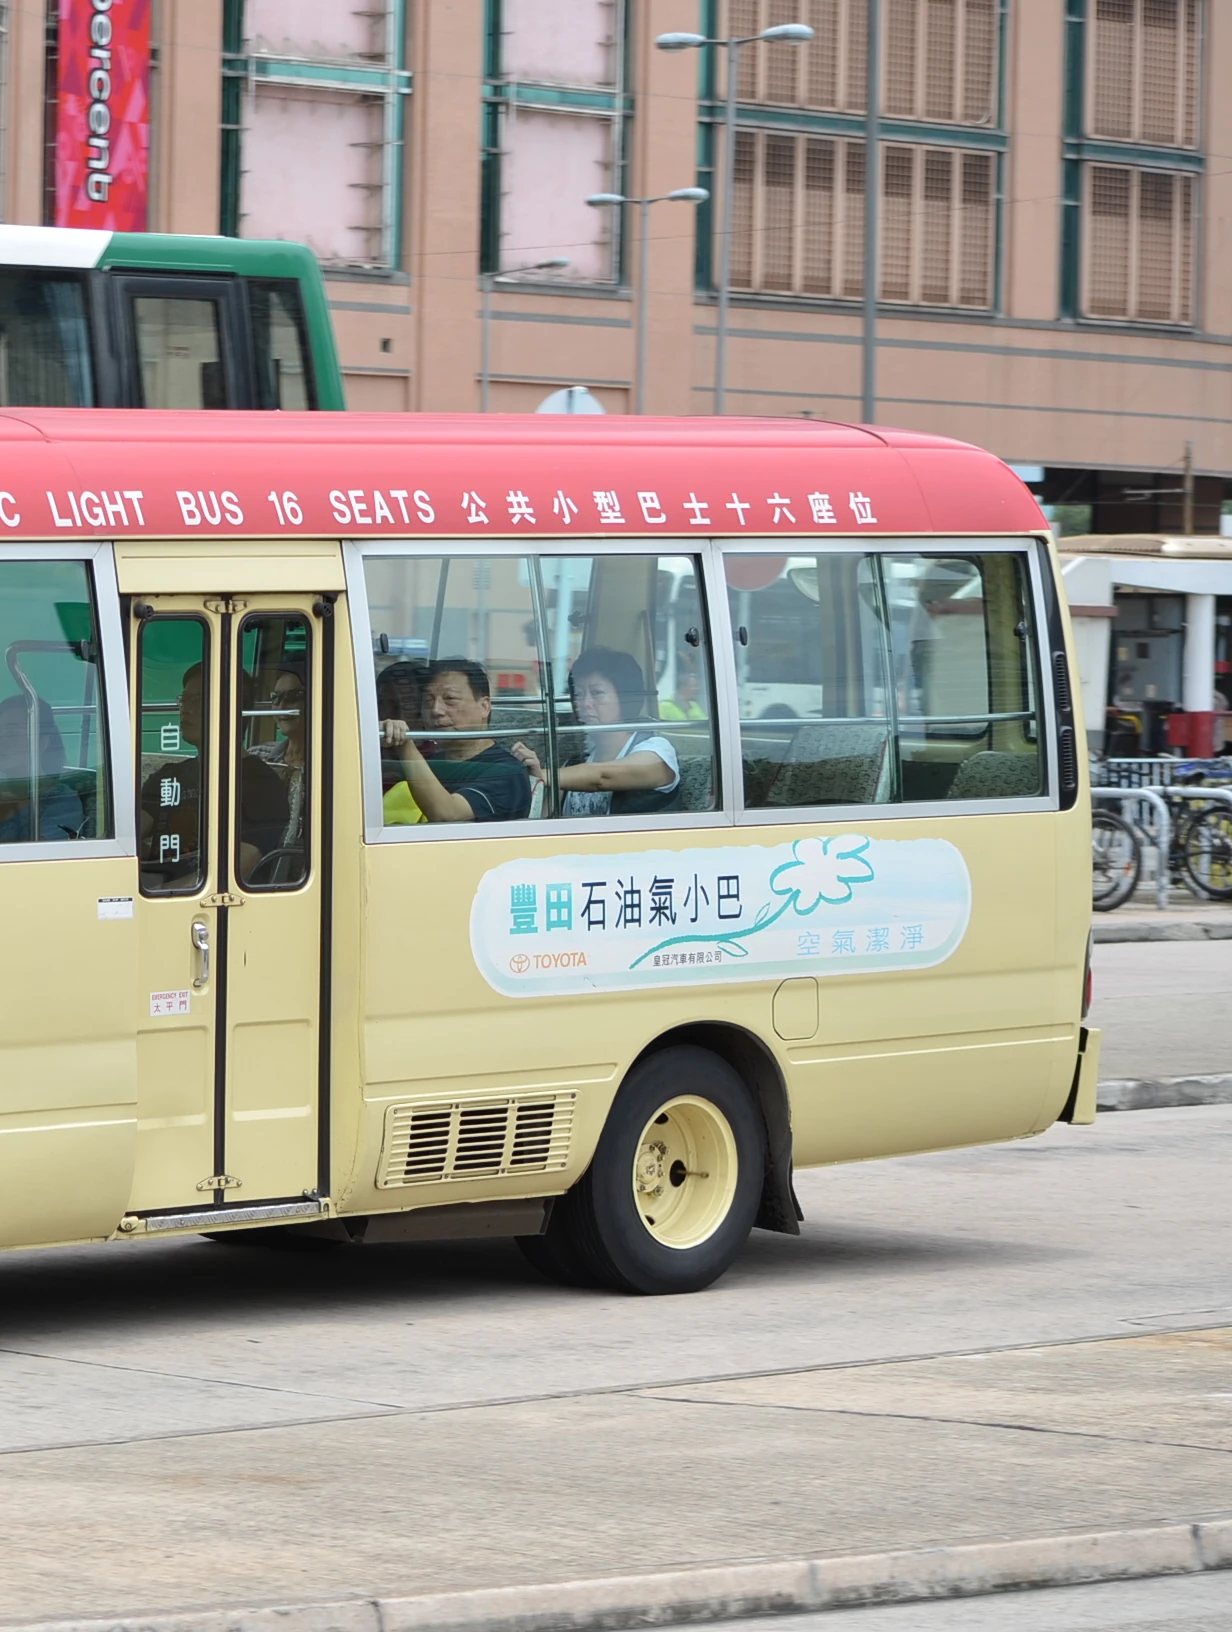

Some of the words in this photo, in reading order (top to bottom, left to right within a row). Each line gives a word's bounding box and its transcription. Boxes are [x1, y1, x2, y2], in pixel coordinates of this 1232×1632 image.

[45, 490, 144, 526] LIGHT
[175, 490, 243, 525] BUS
[267, 490, 303, 524] 16
[329, 489, 434, 524] SEATS
[460, 490, 877, 525] 公共小型巴士十六座位
[160, 722, 181, 864] 自動門
[509, 873, 744, 935] 豐田石油氣小巴
[796, 924, 925, 956] 空氣潔淨
[533, 952, 587, 969] TOYOTA
[653, 950, 722, 967] 皇冠汽車有限公司
[152, 992, 176, 1001] EMERGENCY
